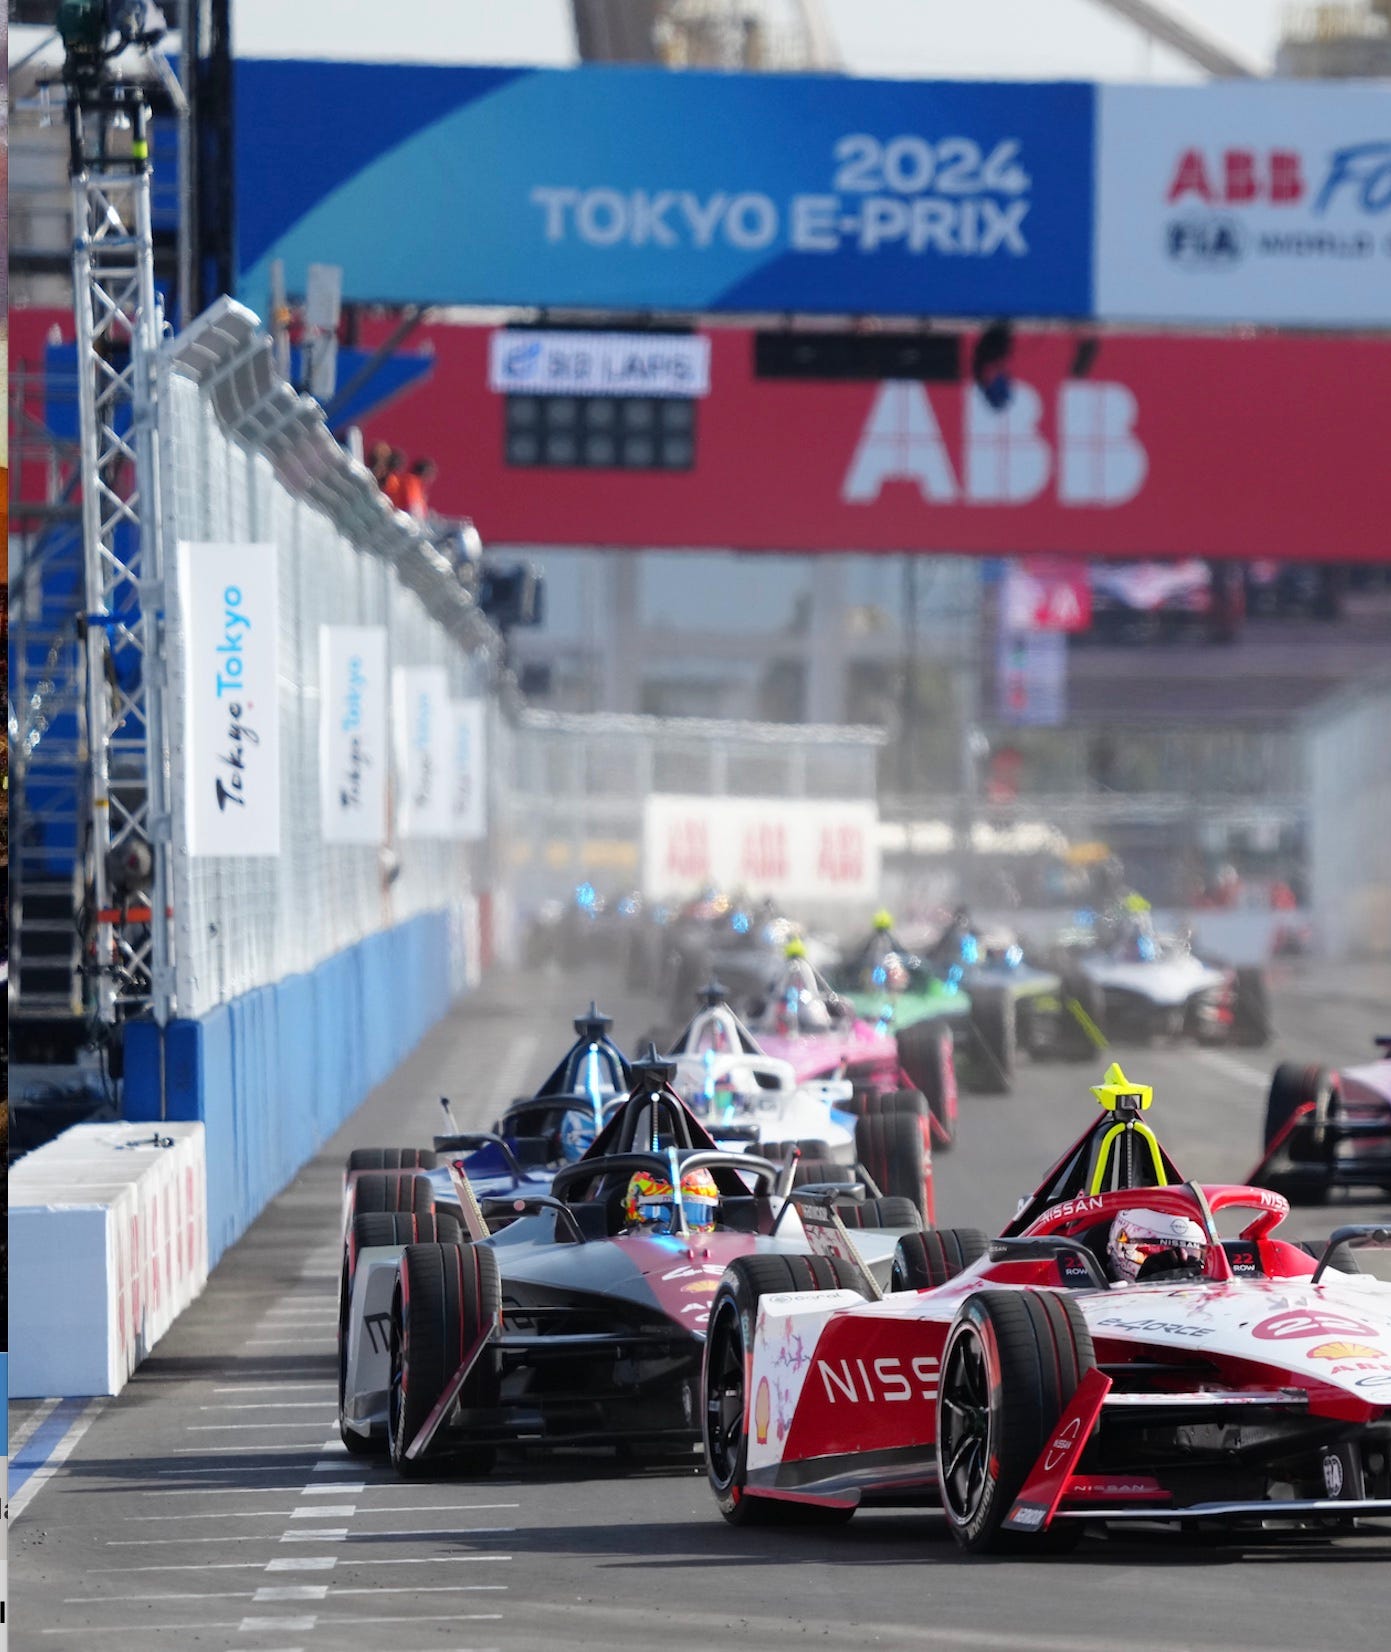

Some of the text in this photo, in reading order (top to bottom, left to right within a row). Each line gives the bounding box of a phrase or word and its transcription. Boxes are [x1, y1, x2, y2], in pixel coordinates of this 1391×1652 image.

[834, 134, 1032, 194] 2024
[1166, 147, 1306, 207] ABB
[531, 186, 1030, 257] TOKYO E-PRIX
[1166, 221, 1240, 259] FIA
[1257, 231, 1374, 258] WORLD
[841, 378, 1148, 507] ABB
[214, 583, 260, 813] Tokyo Tokyo
[1042, 1197, 1103, 1224] NISSAN
[1159, 1239, 1200, 1249] NISSAN
[1066, 1268, 1088, 1276] ROW
[1233, 1253, 1254, 1264] 22
[1233, 1264, 1255, 1272] ROW
[1266, 1315, 1367, 1337] 22
[1073, 1484, 1145, 1492] NISSAN
